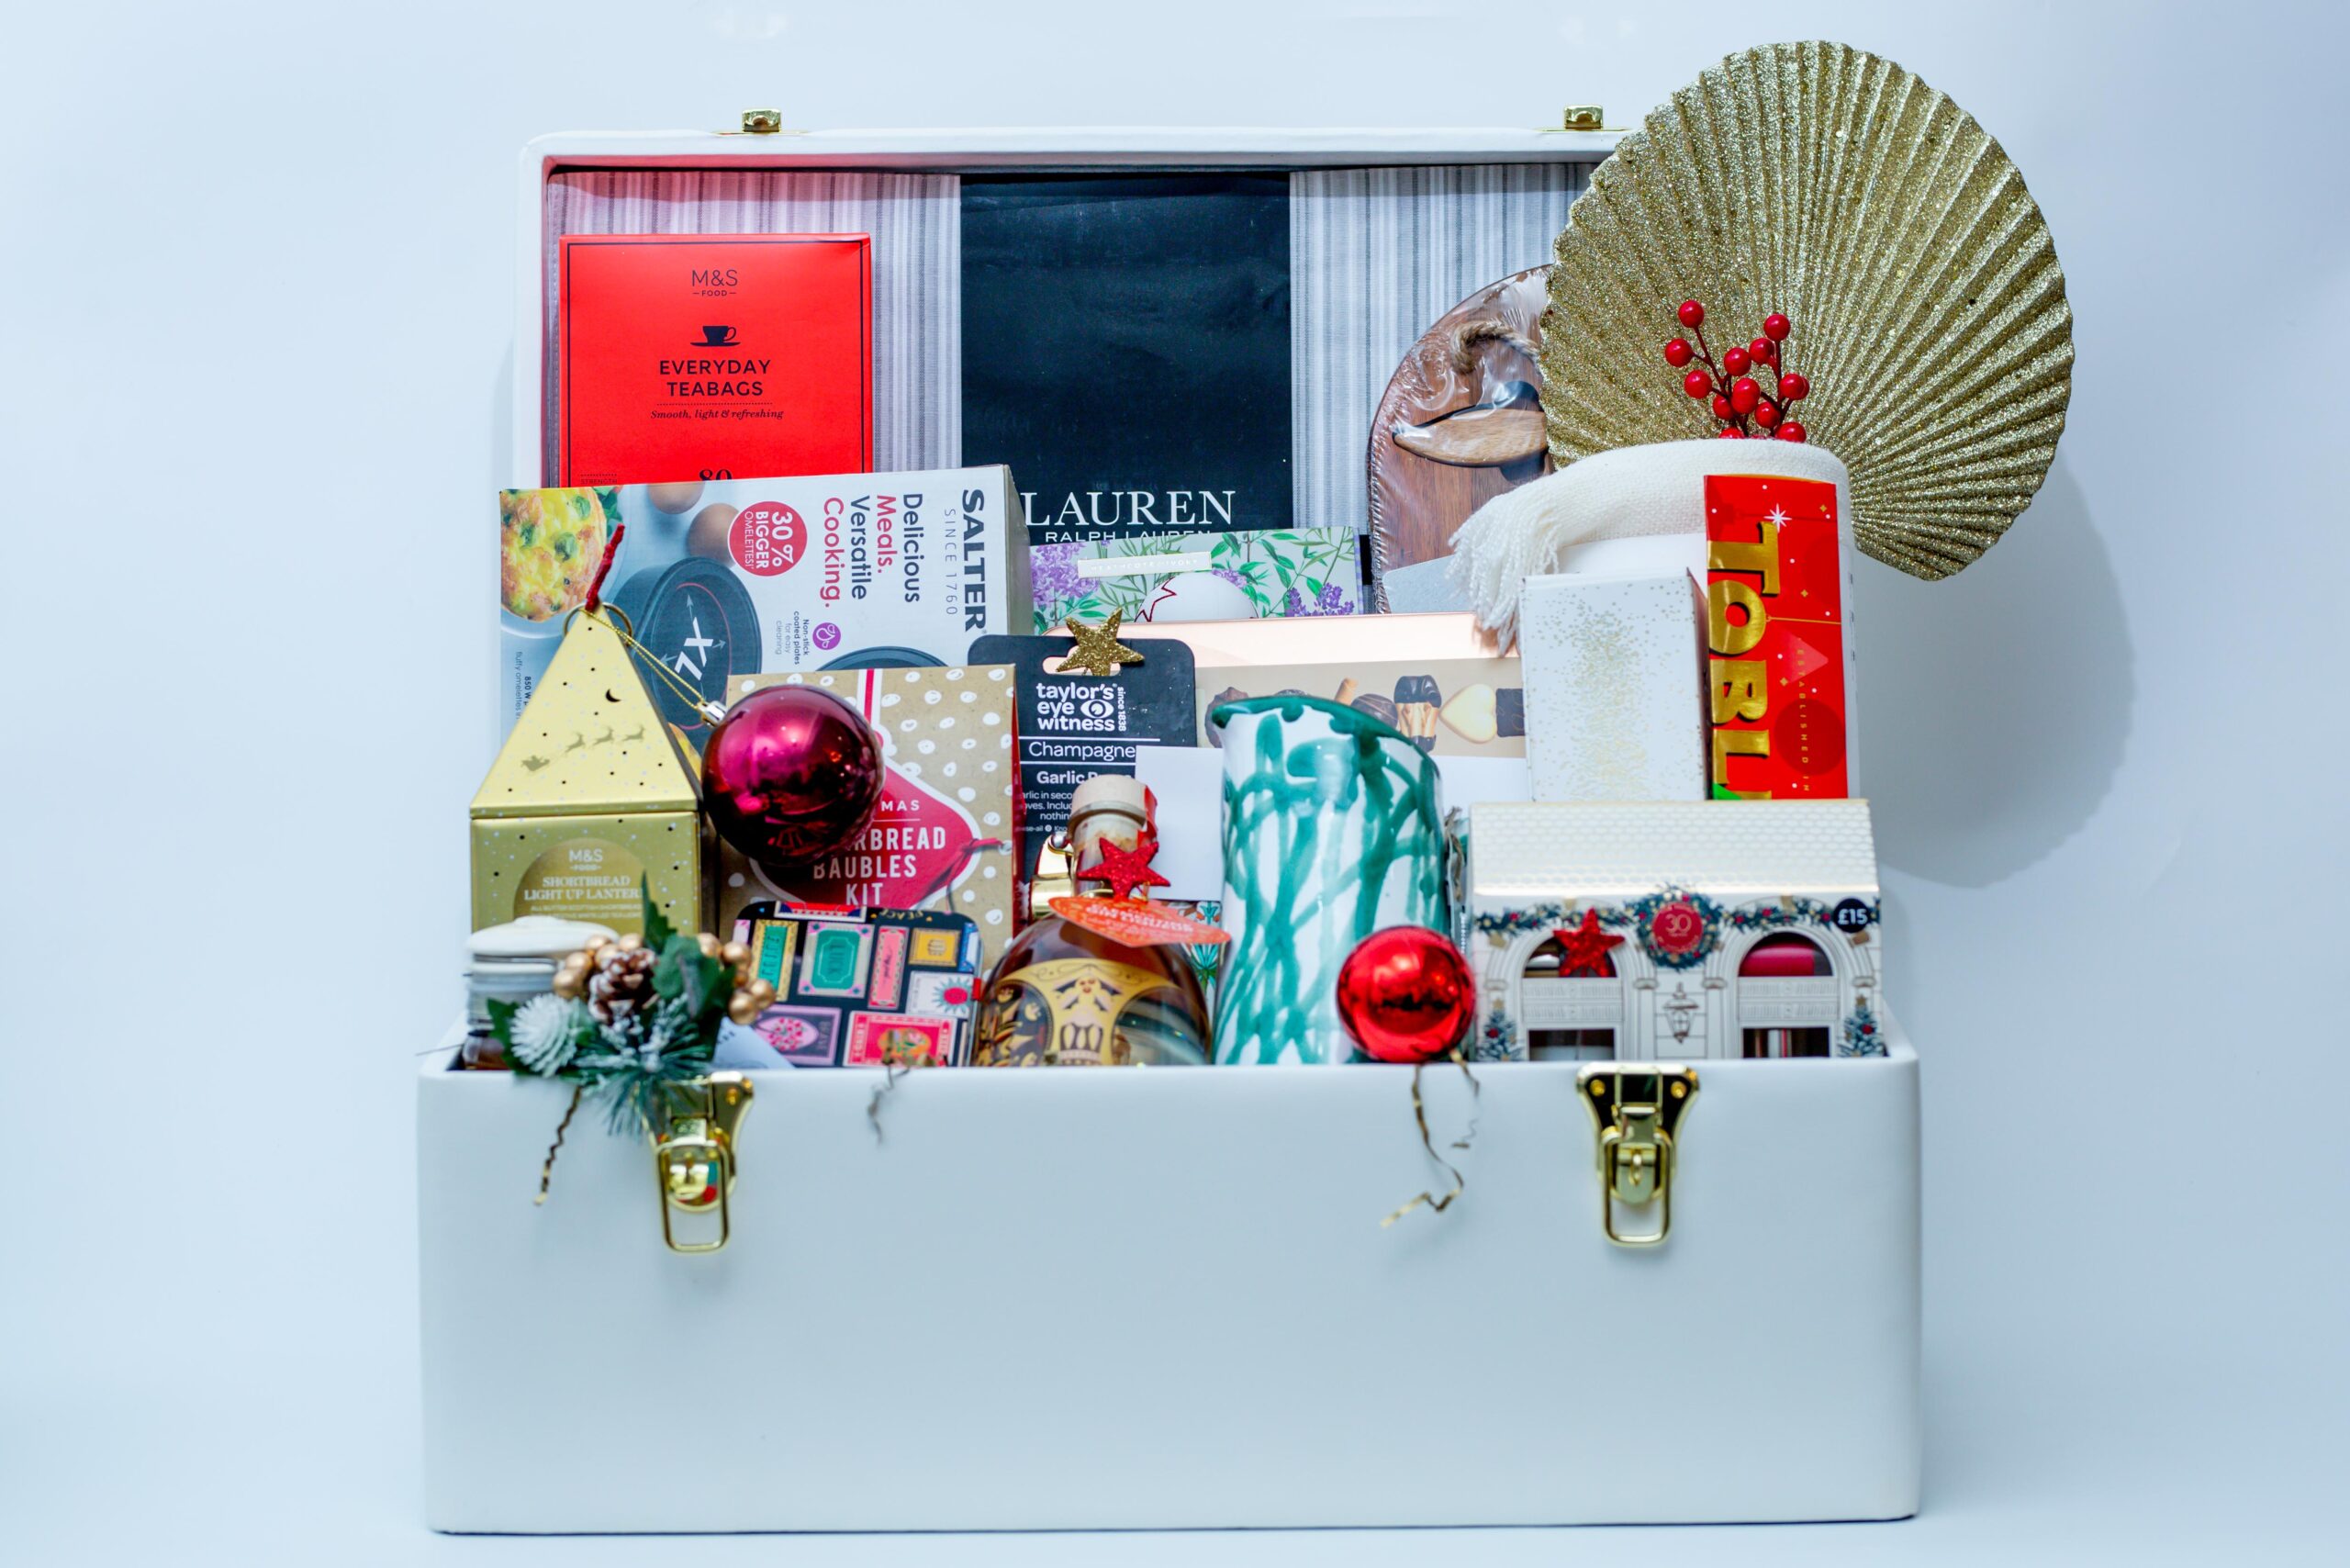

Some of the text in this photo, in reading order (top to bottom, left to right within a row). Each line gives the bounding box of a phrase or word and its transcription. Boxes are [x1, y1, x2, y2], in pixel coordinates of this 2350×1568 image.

[692, 269, 738, 286] M&S
[659, 359, 771, 375] EVERYDAY
[666, 381, 764, 397] TEABAGS
[650, 409, 784, 420] Smooth, light & refreshing
[1019, 490, 1236, 526] LAUREN
[755, 511, 769, 569] BIGGER
[771, 511, 794, 567] 30%
[876, 495, 898, 574] Meals.
[1045, 531, 1116, 543] RALPH
[820, 498, 845, 608] Cooking.
[850, 495, 872, 599] Versatile
[902, 493, 924, 603] Delicious
[944, 509, 958, 615] SINCE 1760
[962, 489, 987, 633] SALTER
[793, 610, 801, 665] coated plates
[515, 651, 523, 672] fluffy
[524, 676, 532, 690] 850
[1036, 682, 1114, 703] taylor's
[1036, 700, 1075, 718] eye
[1117, 686, 1127, 732] since 1838
[1037, 715, 1115, 732] witness
[1028, 742, 1136, 761] Champagne
[1036, 770, 1085, 784] Garlic
[1021, 790, 1039, 800] arlic
[1041, 790, 1049, 800] in
[881, 800, 920, 812] MAS
[569, 847, 603, 862] M&S
[813, 854, 917, 879] BAUBLES
[542, 875, 632, 888] SHORTBREAD
[524, 889, 563, 901] LIGHT
[565, 888, 585, 900] UP
[845, 882, 884, 906] KIT
[1665, 913, 1692, 933] 30
[1837, 908, 1869, 925] £15
